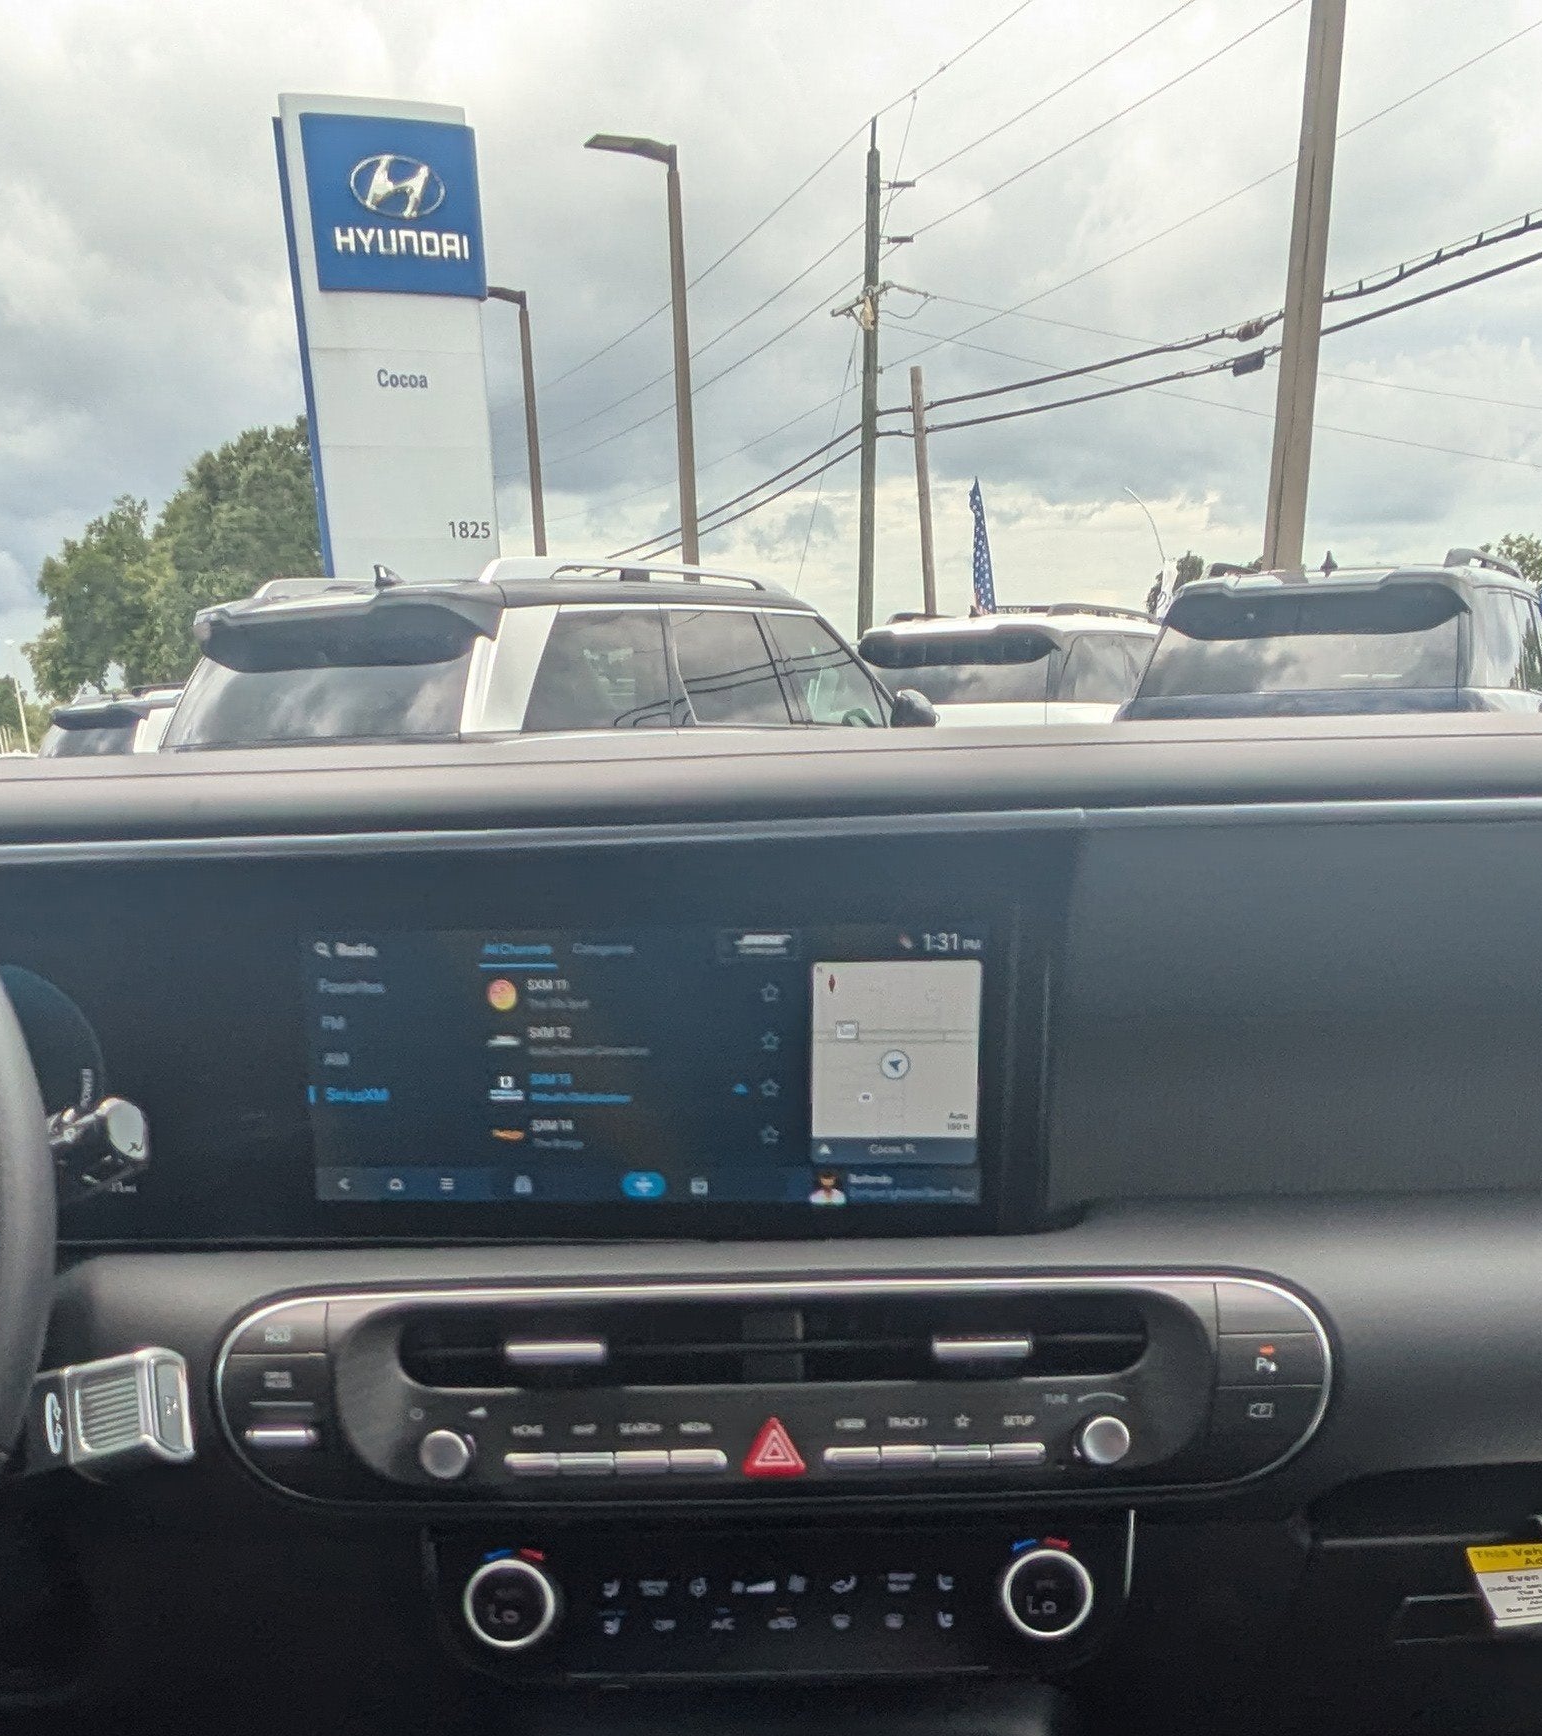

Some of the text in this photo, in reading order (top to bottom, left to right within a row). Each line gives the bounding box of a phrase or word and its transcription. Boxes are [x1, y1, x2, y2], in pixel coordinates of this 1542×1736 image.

[334, 226, 470, 261] HYUNDAI
[377, 368, 428, 390] Cocoa
[448, 520, 491, 540] 1825
[922, 932, 959, 951] 1:31
[1474, 1550, 1509, 1559] This
[1507, 1574, 1540, 1583] Even
